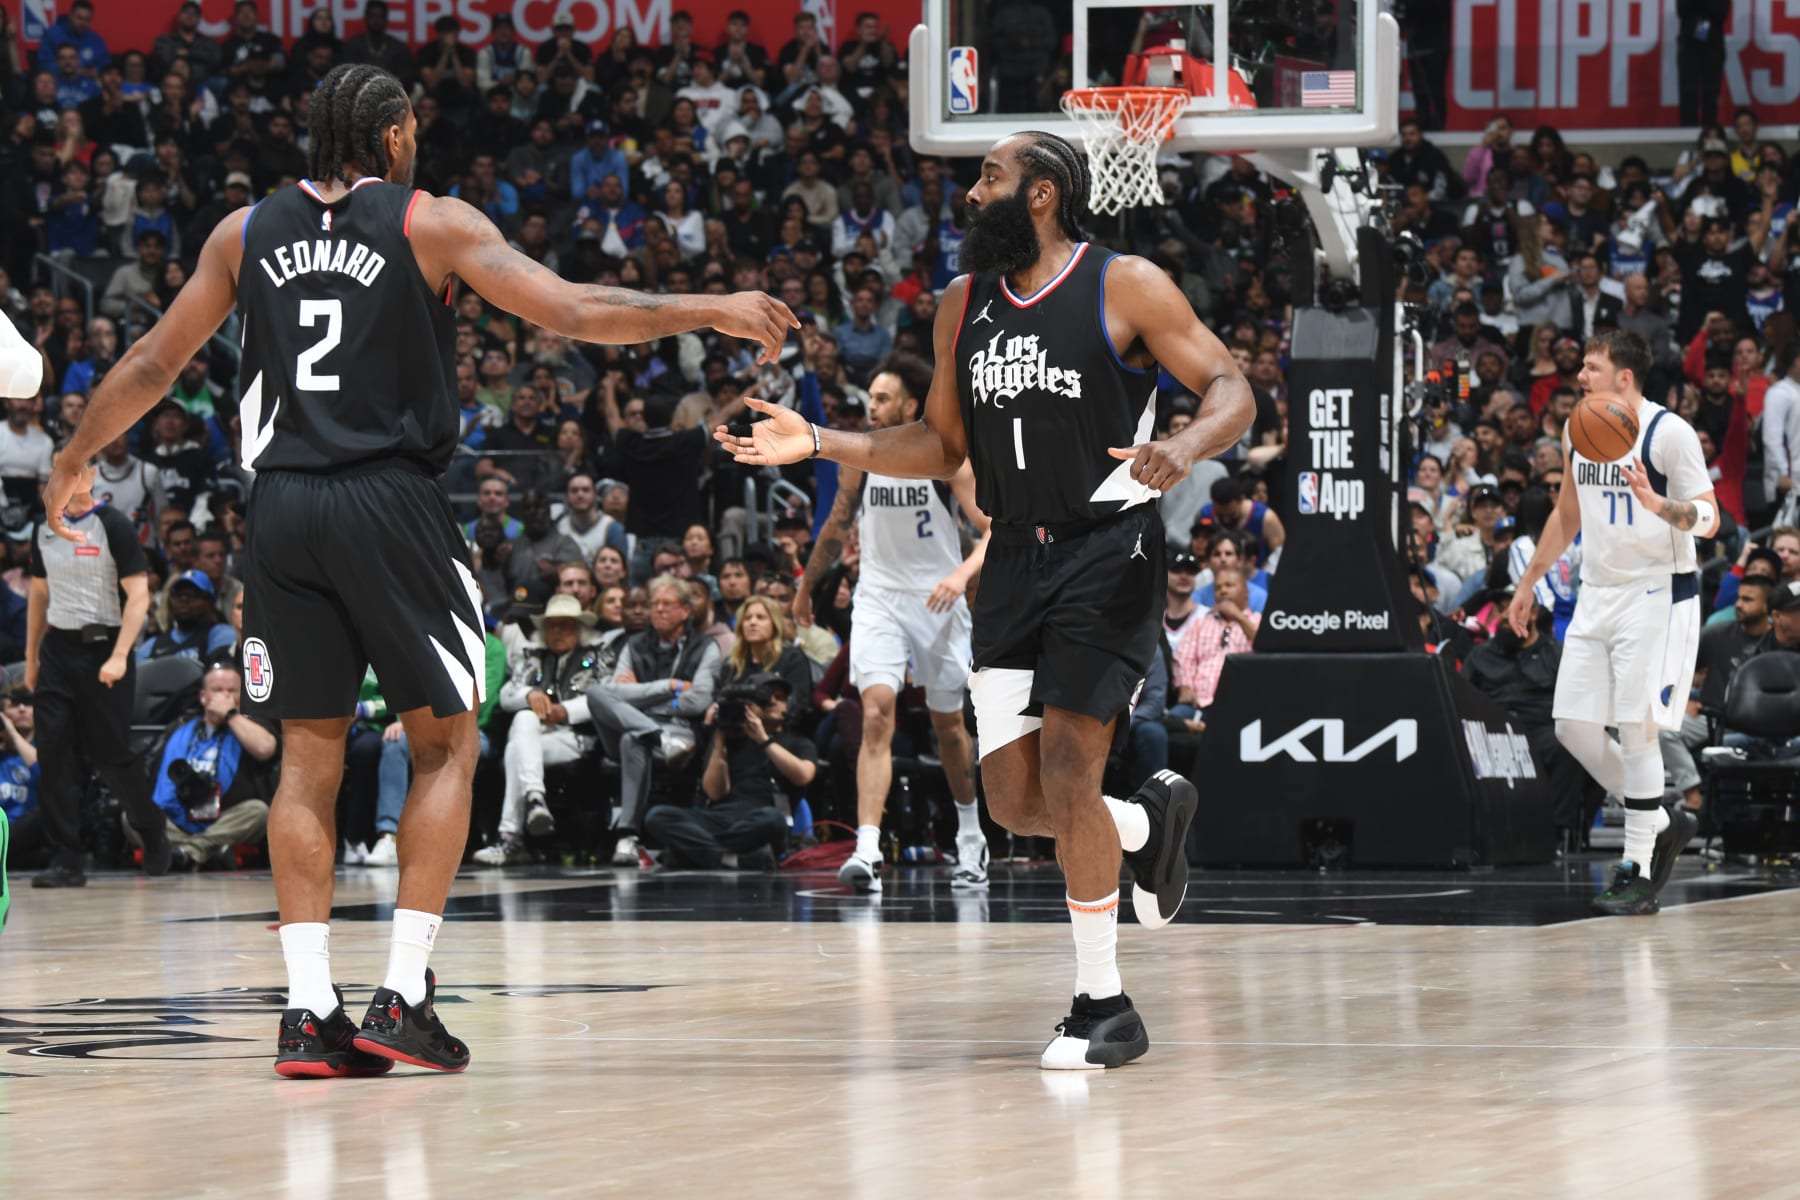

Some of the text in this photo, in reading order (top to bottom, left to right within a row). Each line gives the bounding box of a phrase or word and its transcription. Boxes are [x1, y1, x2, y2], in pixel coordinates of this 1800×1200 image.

[259, 239, 386, 288] LEONARD
[296, 299, 343, 391] 2
[984, 329, 1040, 366] Los
[969, 348, 1082, 409] Angeles
[1308, 388, 1354, 429] GET
[1013, 417, 1026, 470] 1
[1308, 429, 1354, 470] THE
[870, 485, 929, 508] DALLAS
[1319, 472, 1365, 521] App
[1602, 490, 1633, 526] 77
[915, 509, 934, 539] 2
[1269, 610, 1389, 635] Google Pixel
[1240, 718, 1418, 763] KIA
